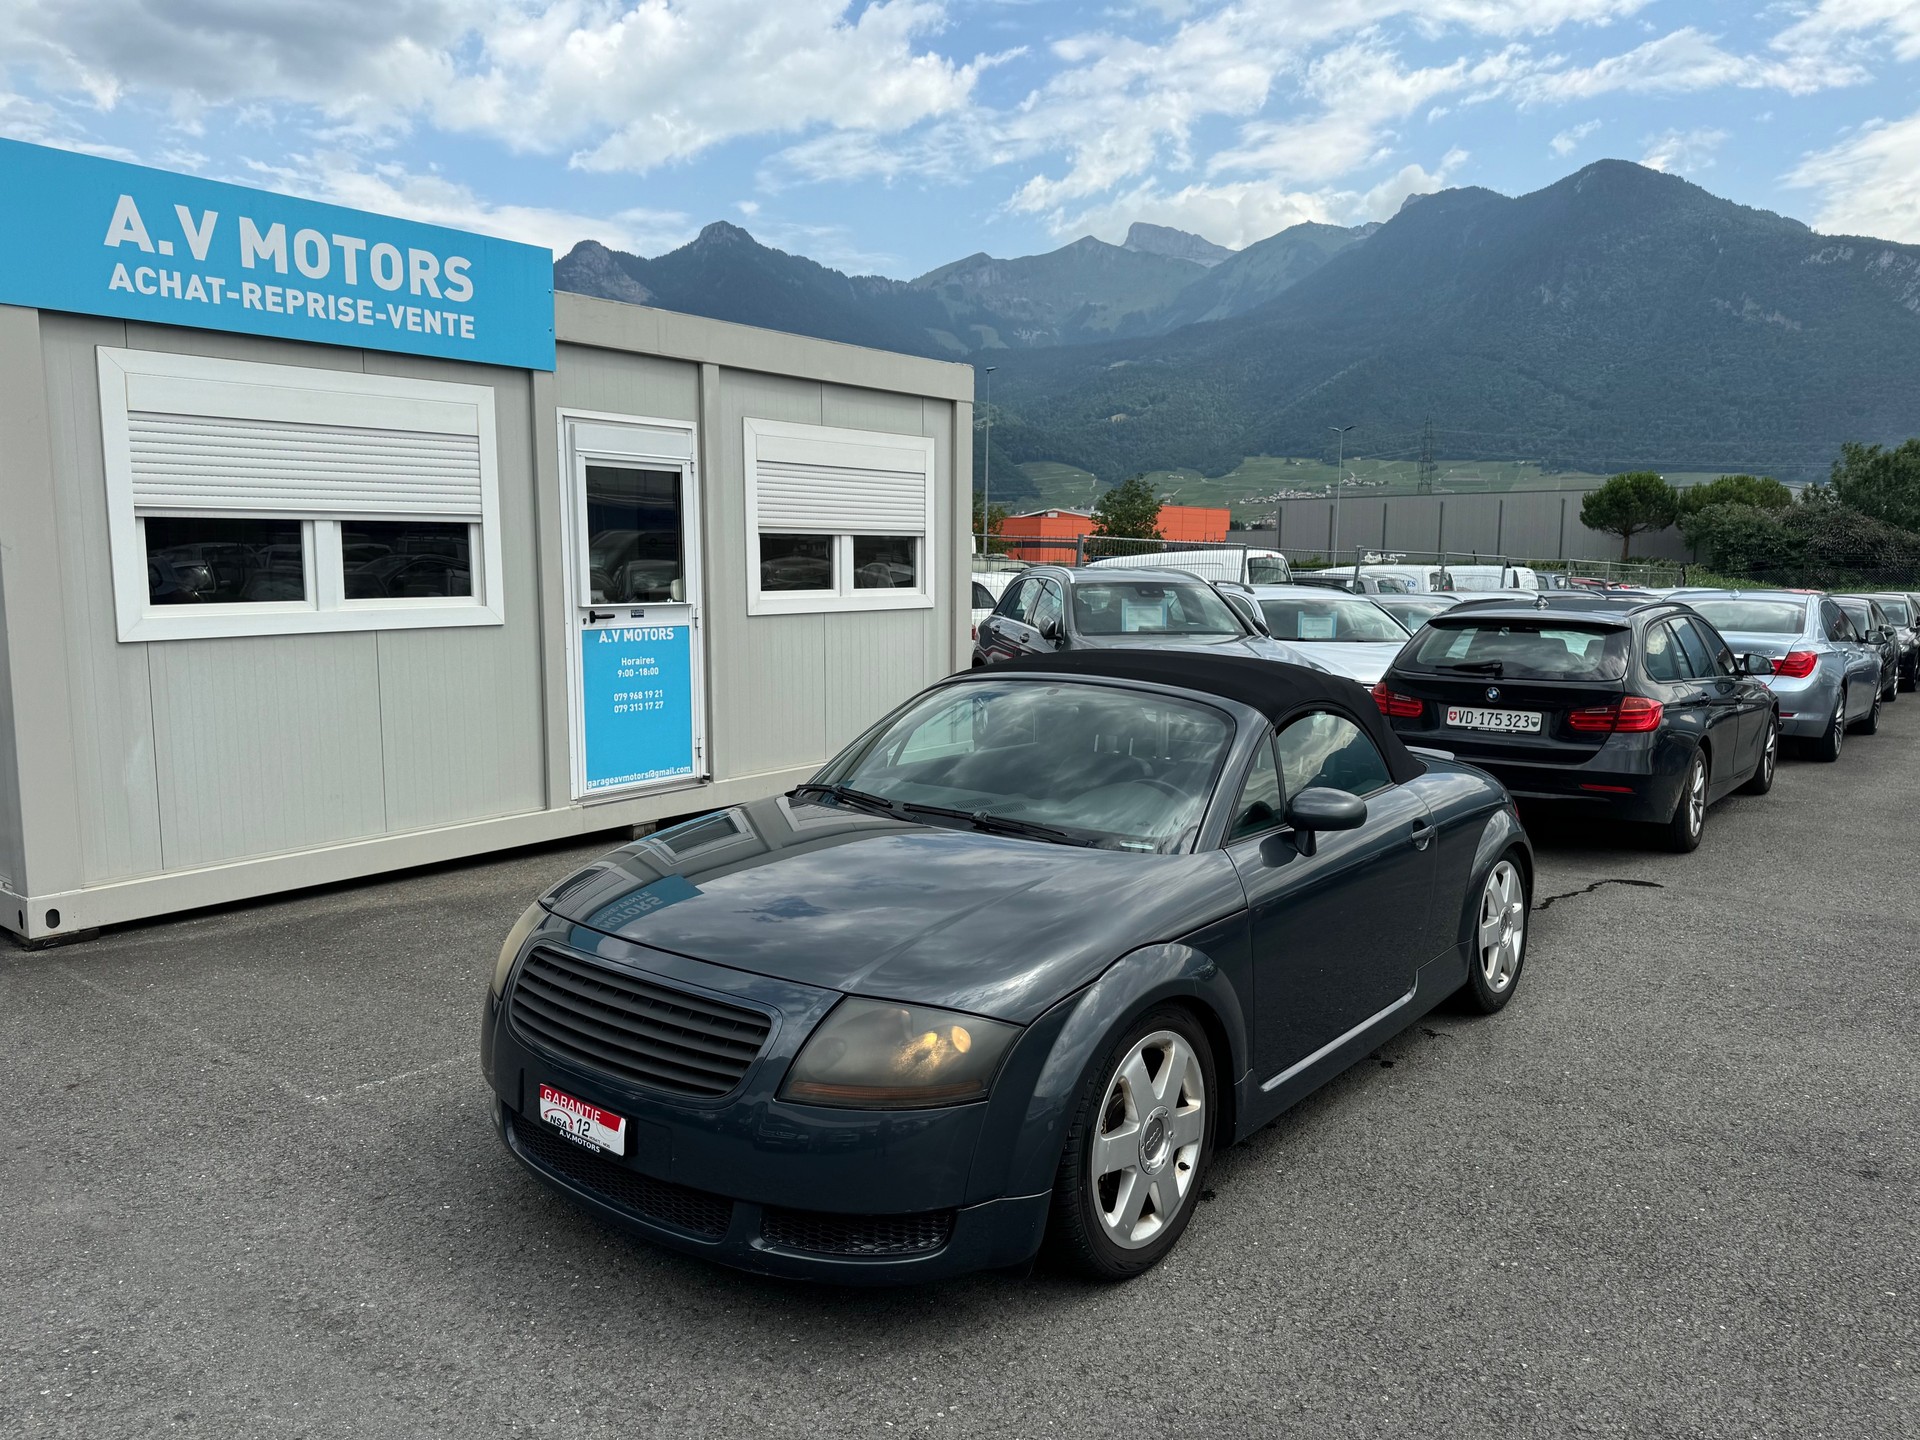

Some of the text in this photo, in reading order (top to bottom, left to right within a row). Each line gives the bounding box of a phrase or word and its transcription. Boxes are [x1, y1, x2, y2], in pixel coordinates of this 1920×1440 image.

[103, 194, 475, 303] A.V MOTORS
[108, 263, 476, 340] ACHAT-REPRISE-VENTE
[598, 627, 674, 643] A.V MOTORS
[621, 656, 655, 666] Horaires
[617, 668, 634, 678] 9:00
[613, 689, 663, 702] 079 968 19 21
[614, 700, 664, 714] 079 313 17 27
[587, 765, 692, 789] garageavmotors@gmail.com
[544, 1089, 601, 1124] GARANTIE
[550, 1115, 567, 1130] NSA
[576, 1118, 591, 1138] 12
